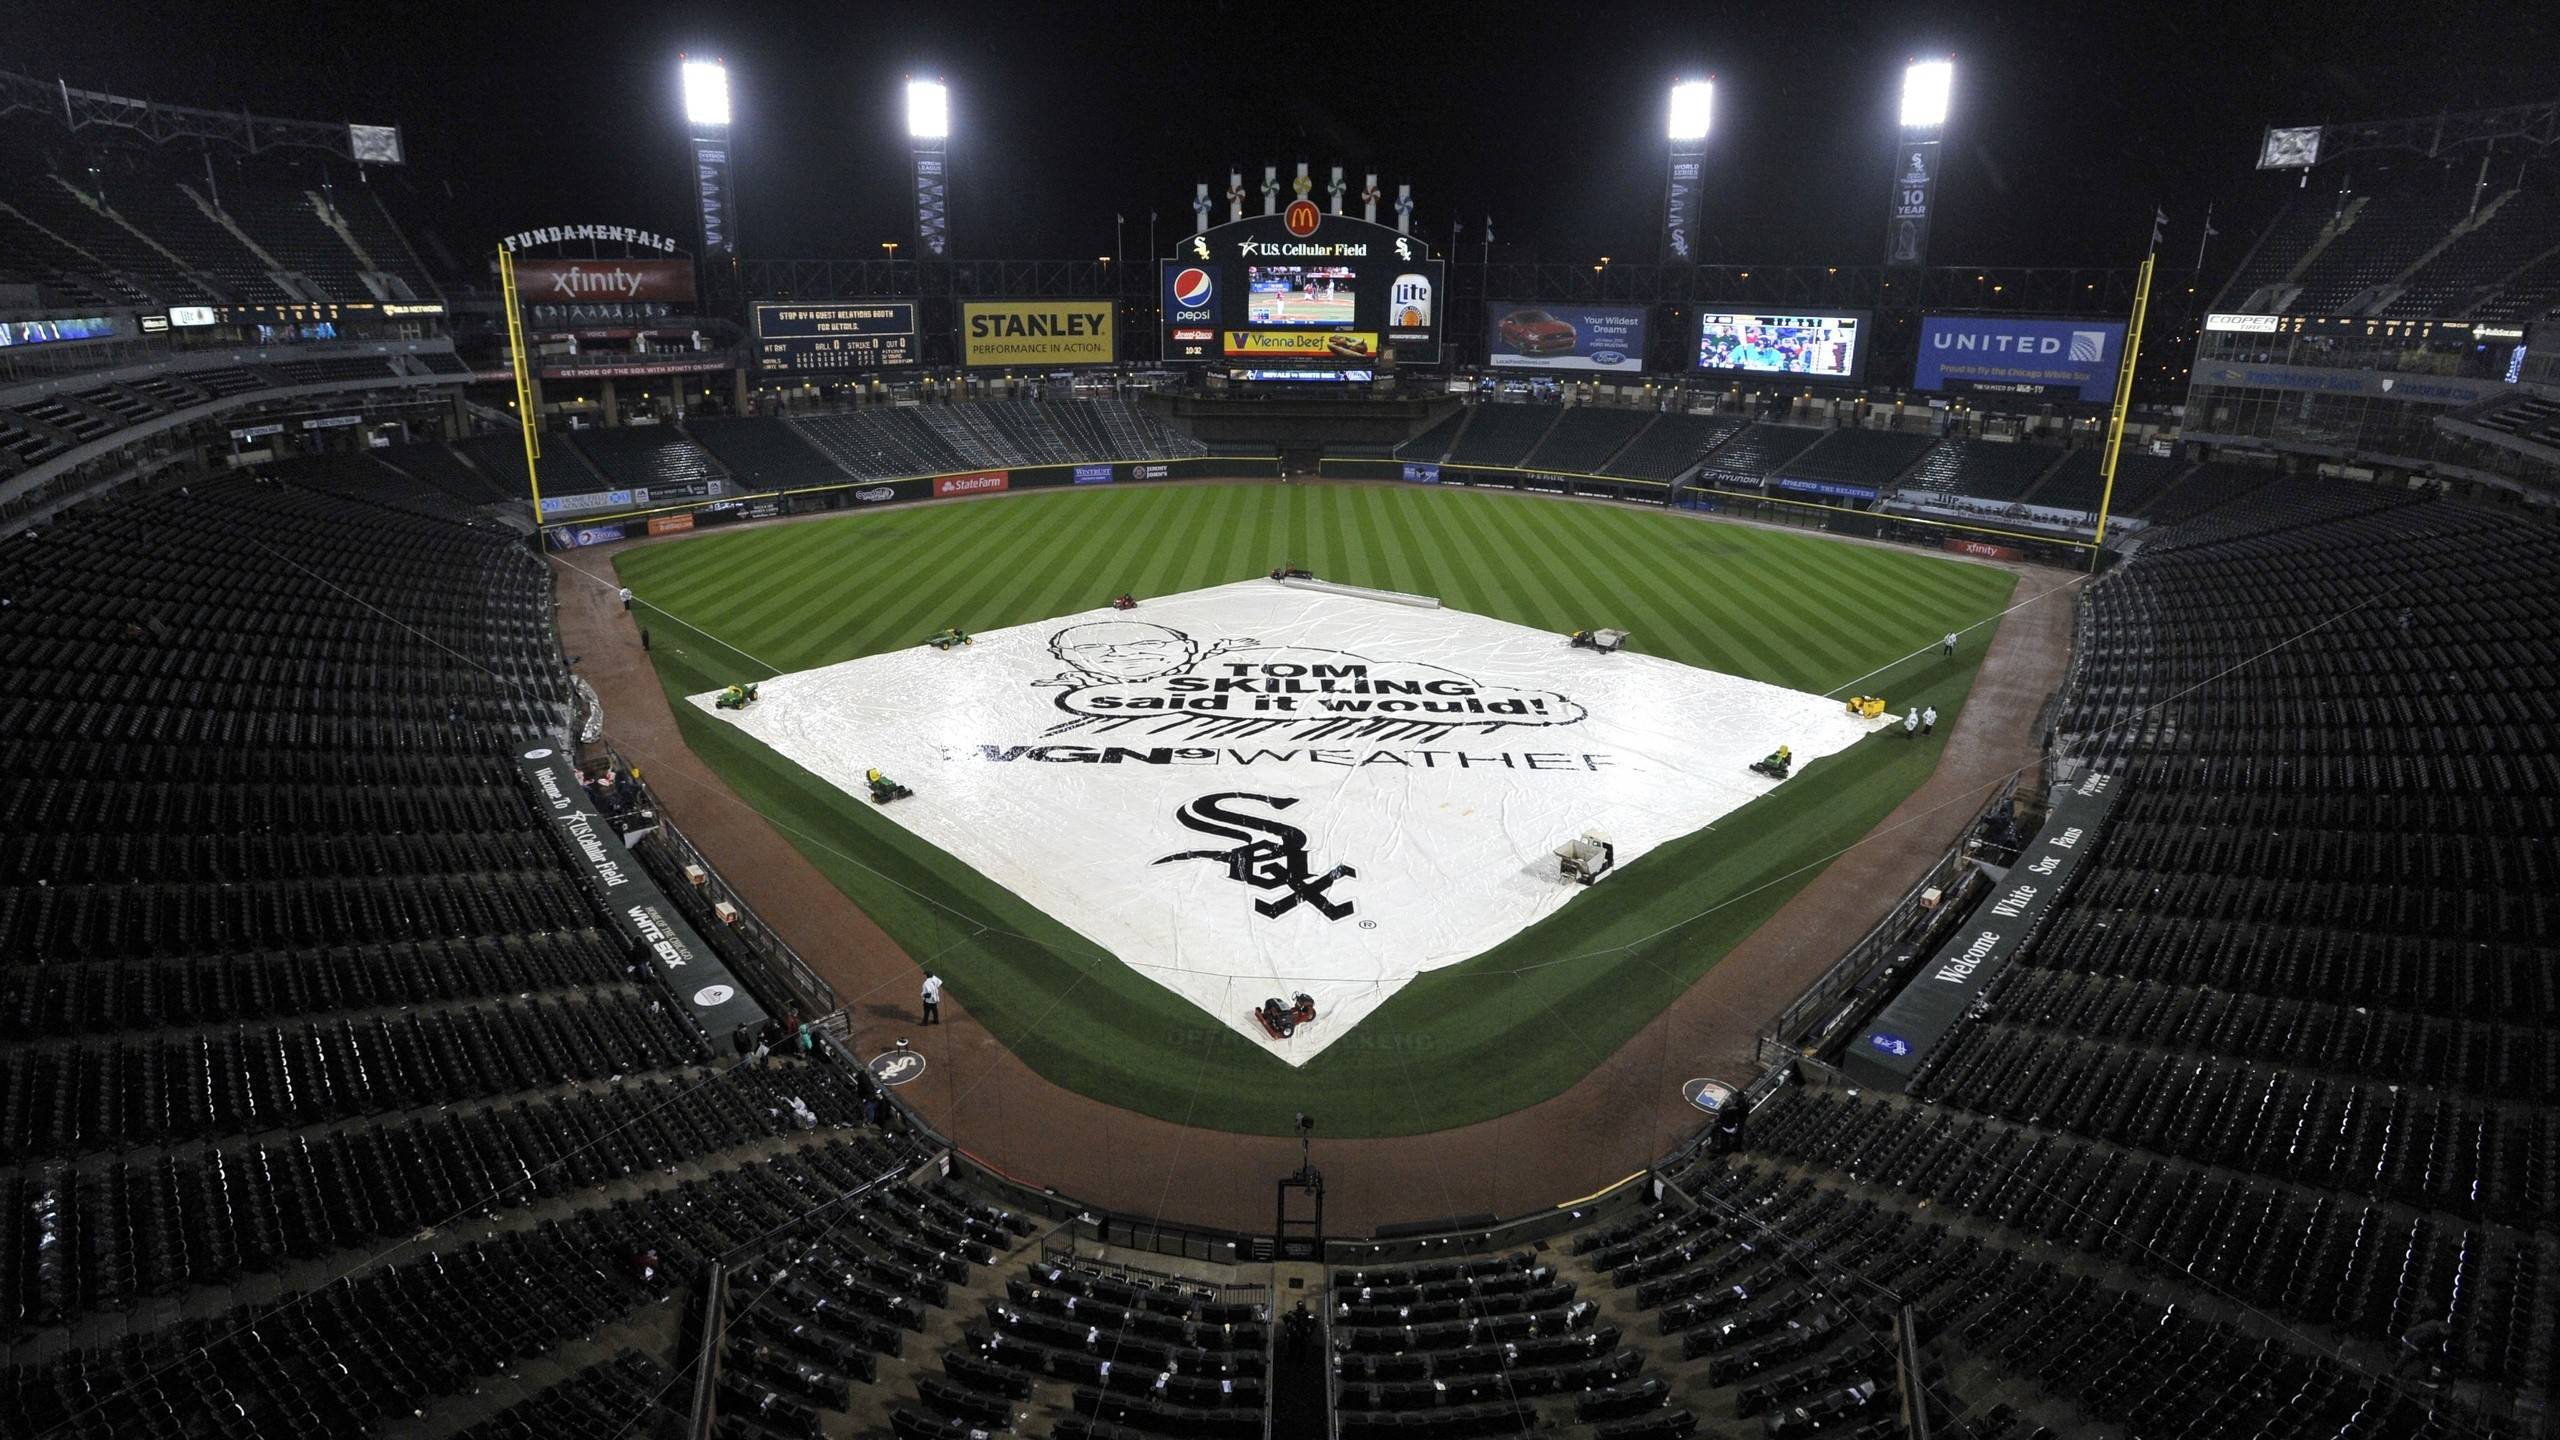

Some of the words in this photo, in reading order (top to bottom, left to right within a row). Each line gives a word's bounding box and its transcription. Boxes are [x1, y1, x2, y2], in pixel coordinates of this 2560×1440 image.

[1902, 190, 1925, 205] 10
[1898, 206, 1926, 215] YEAR
[504, 224, 675, 252] FUNDAMENTALS
[1282, 243, 1332, 256] Cellular
[1335, 243, 1367, 256] Field
[552, 266, 643, 298] xfinity
[1396, 284, 1427, 304] Lite
[779, 312, 797, 320] STOP
[815, 311, 836, 319] GUEST
[1176, 309, 1210, 322] pepsi
[1583, 316, 1603, 325] Your
[1605, 316, 1638, 326] Wildest
[2210, 316, 2276, 324] COOPER
[971, 313, 1103, 337] STANLEY
[1593, 325, 1627, 334] Dreams
[973, 344, 1047, 354] PERFORMANCE
[1050, 344, 1060, 352] IN
[1252, 334, 1295, 348] Vienna
[1296, 335, 1325, 350] Beef
[1934, 332, 2061, 354] UNITED
[1597, 351, 1621, 363] Ford
[561, 369, 576, 377] GET
[577, 369, 599, 377] MORE
[601, 368, 611, 376] OF
[613, 367, 628, 375] THE
[1940, 364, 1965, 373] Proud
[1966, 365, 1976, 373] to
[1977, 365, 1990, 376] fly
[1992, 366, 2006, 375] the
[2008, 368, 2042, 378] Chicago
[2044, 369, 2072, 379] White
[2074, 371, 2091, 380] Sox
[1076, 467, 1111, 476] WINTRUST
[1718, 473, 1760, 484] HYUNDAI
[1781, 479, 1817, 489] ATHLETICO
[1821, 485, 1834, 493] THE
[1966, 543, 1998, 556] xfinity
[1222, 662, 1367, 678] TOM
[1163, 676, 1482, 695] SKILLING
[1089, 694, 1228, 712] said
[1253, 693, 1299, 711] it
[1318, 695, 1547, 714] would!
[577, 834, 607, 863] Cellular
[595, 861, 628, 887] Field
[1934, 931, 2000, 984] Welcome
[1992, 885, 2037, 918] White
[2028, 856, 2061, 875] Sox
[2049, 827, 2083, 849] Fans
[627, 904, 665, 942] WHITE
[653, 940, 687, 969] SOX
